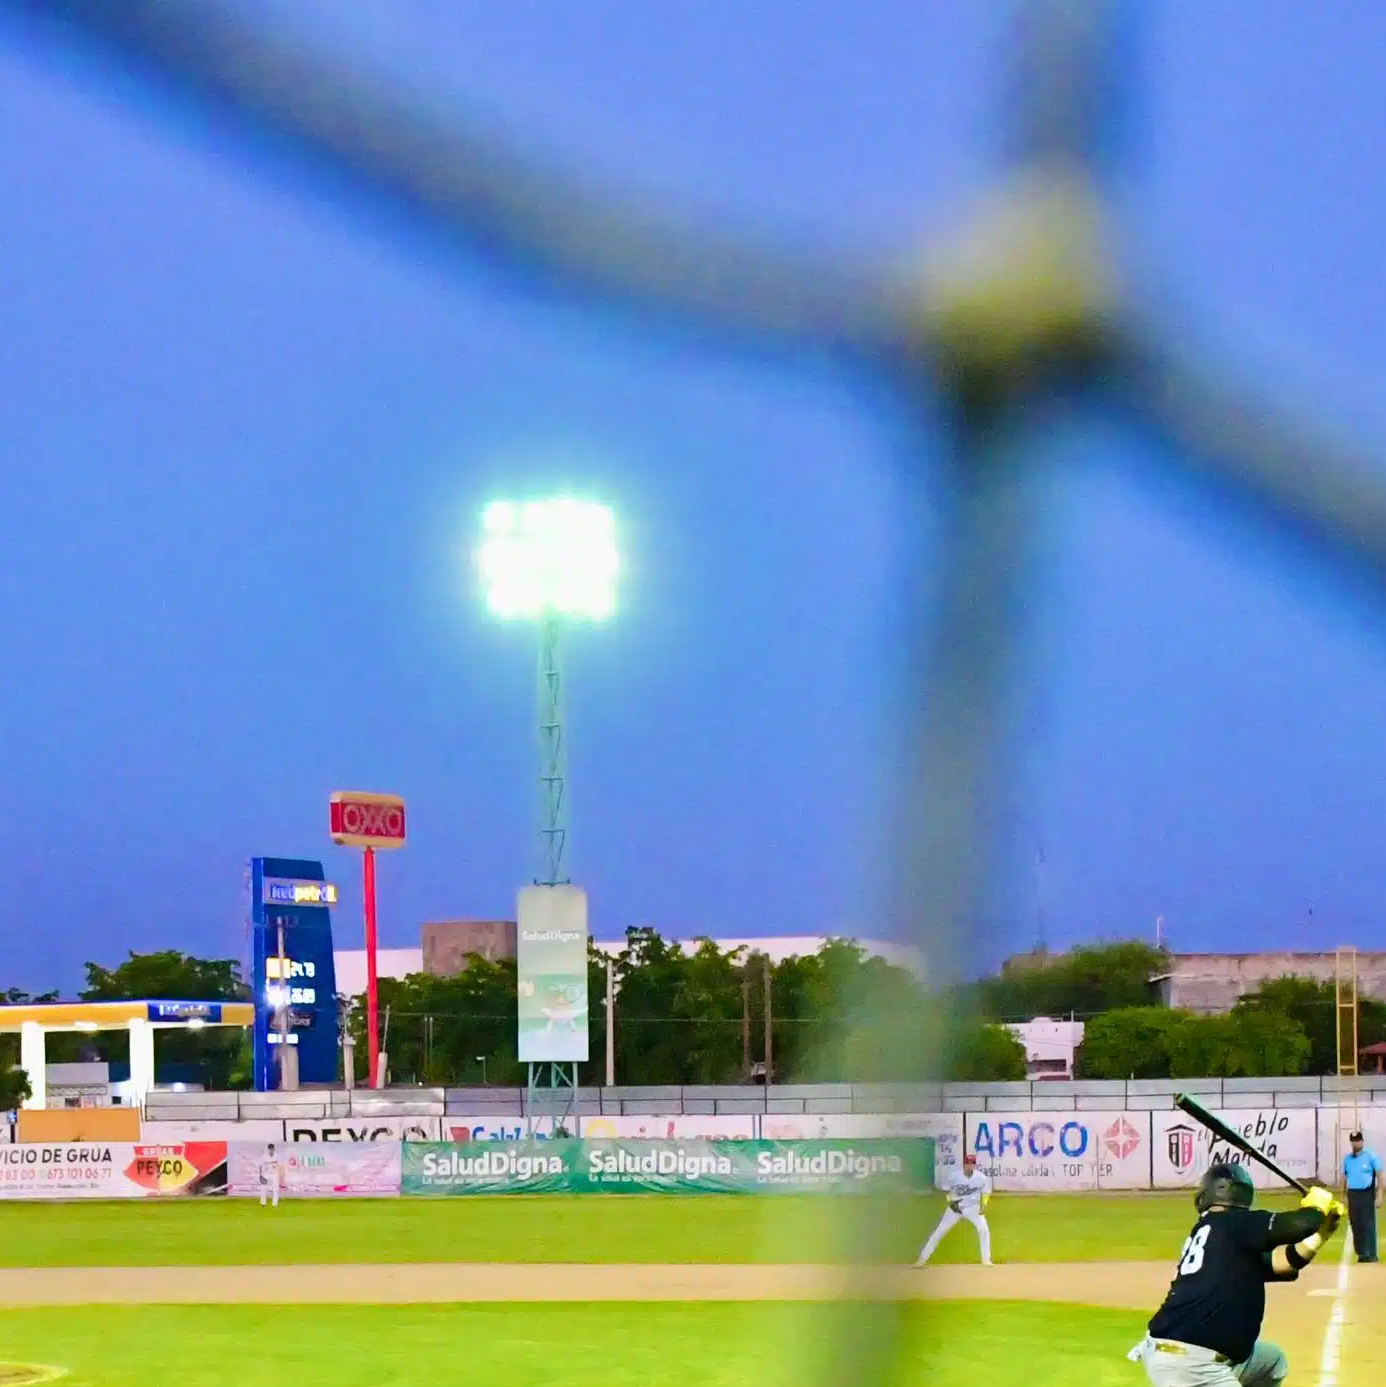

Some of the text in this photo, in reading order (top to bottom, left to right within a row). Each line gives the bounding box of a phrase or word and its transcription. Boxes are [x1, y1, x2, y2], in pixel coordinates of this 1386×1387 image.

[343, 803, 402, 835] OXXO
[974, 1121, 1088, 1158] ARCO
[41, 1149, 62, 1164] DE
[137, 1160, 183, 1176] PEYCO
[423, 1151, 562, 1180] SaludDigna
[589, 1149, 731, 1179] SaludDigna
[757, 1150, 902, 1179] SaludDigna
